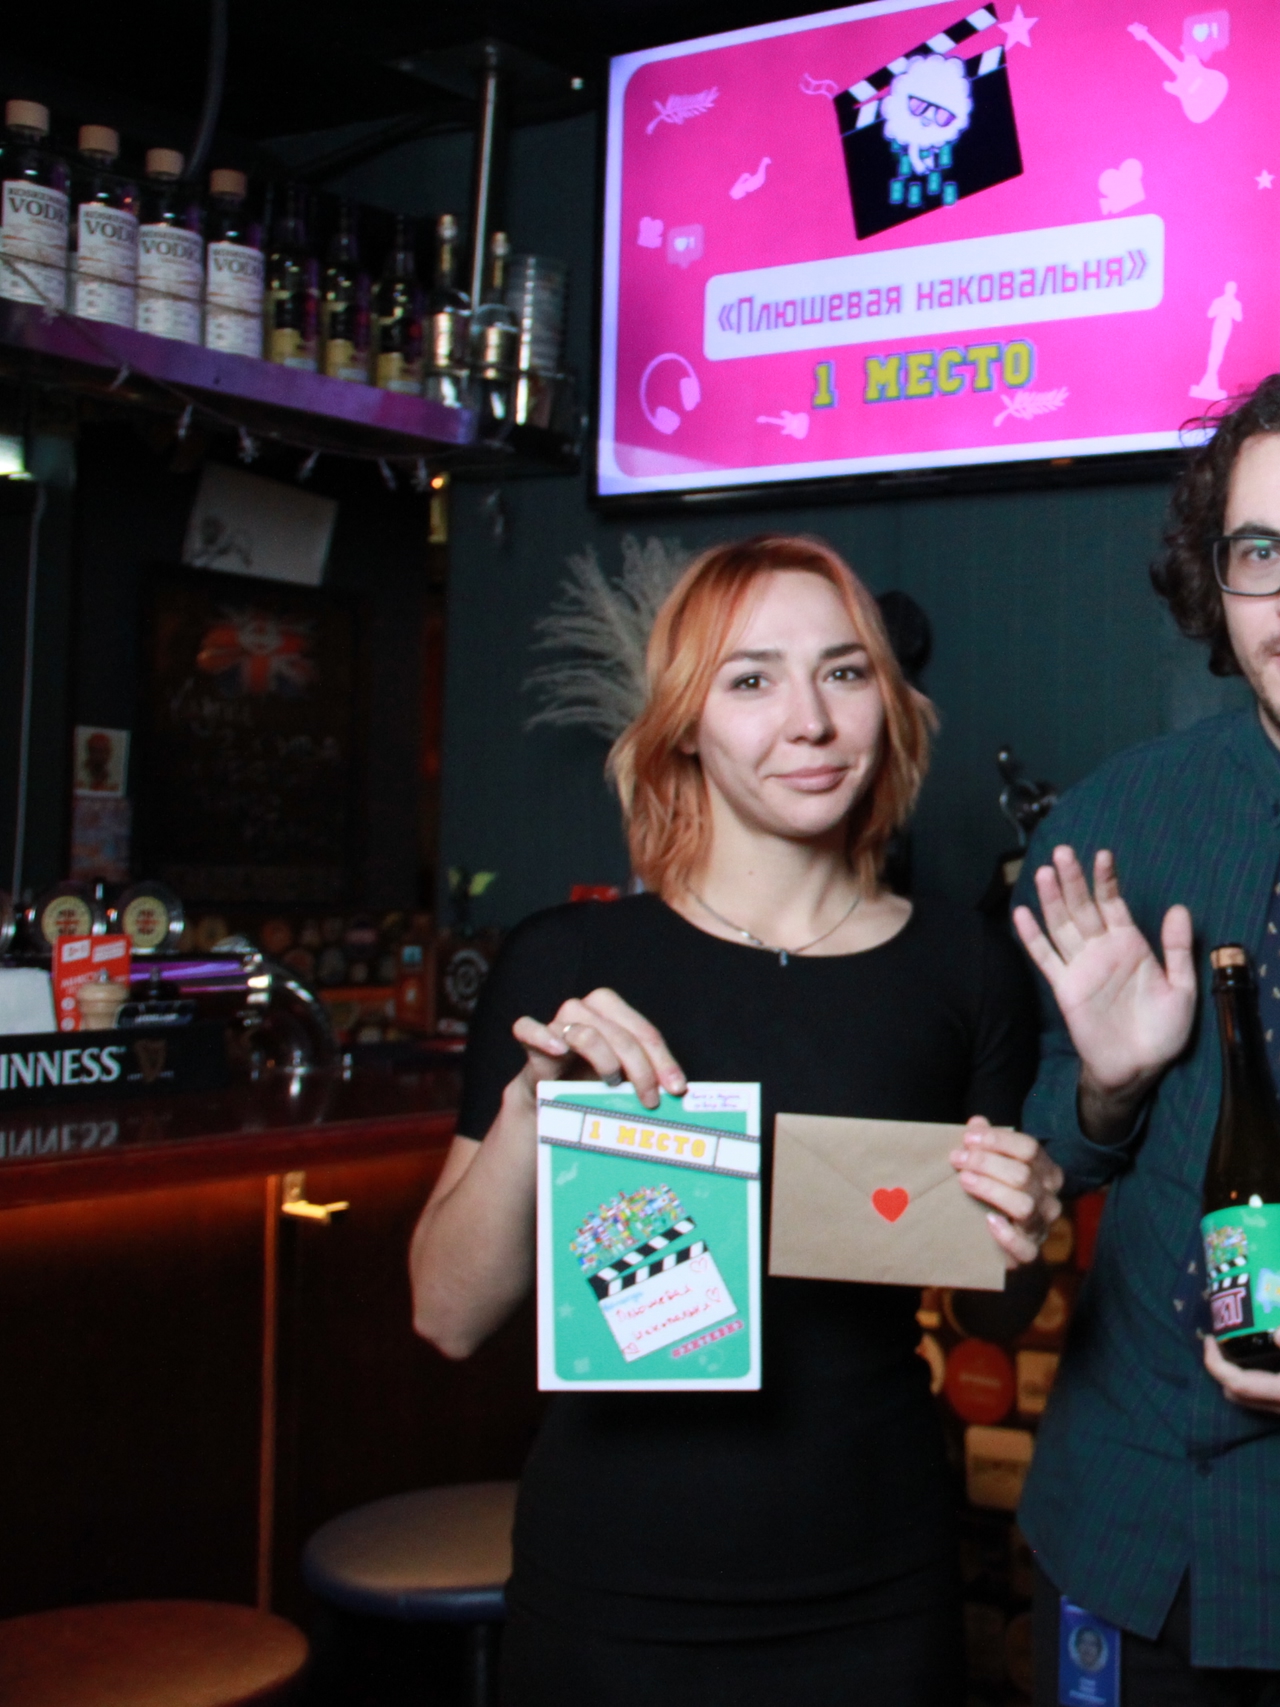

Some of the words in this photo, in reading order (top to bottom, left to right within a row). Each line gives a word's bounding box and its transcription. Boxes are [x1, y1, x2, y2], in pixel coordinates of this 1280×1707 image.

[717, 284, 903, 335] «Плюшевая
[915, 248, 1148, 312] наковальня»
[812, 362, 835, 409] 1
[864, 339, 1034, 404] МЕСТО
[588, 1120, 600, 1139] 1
[617, 1126, 706, 1158] МЕСТО
